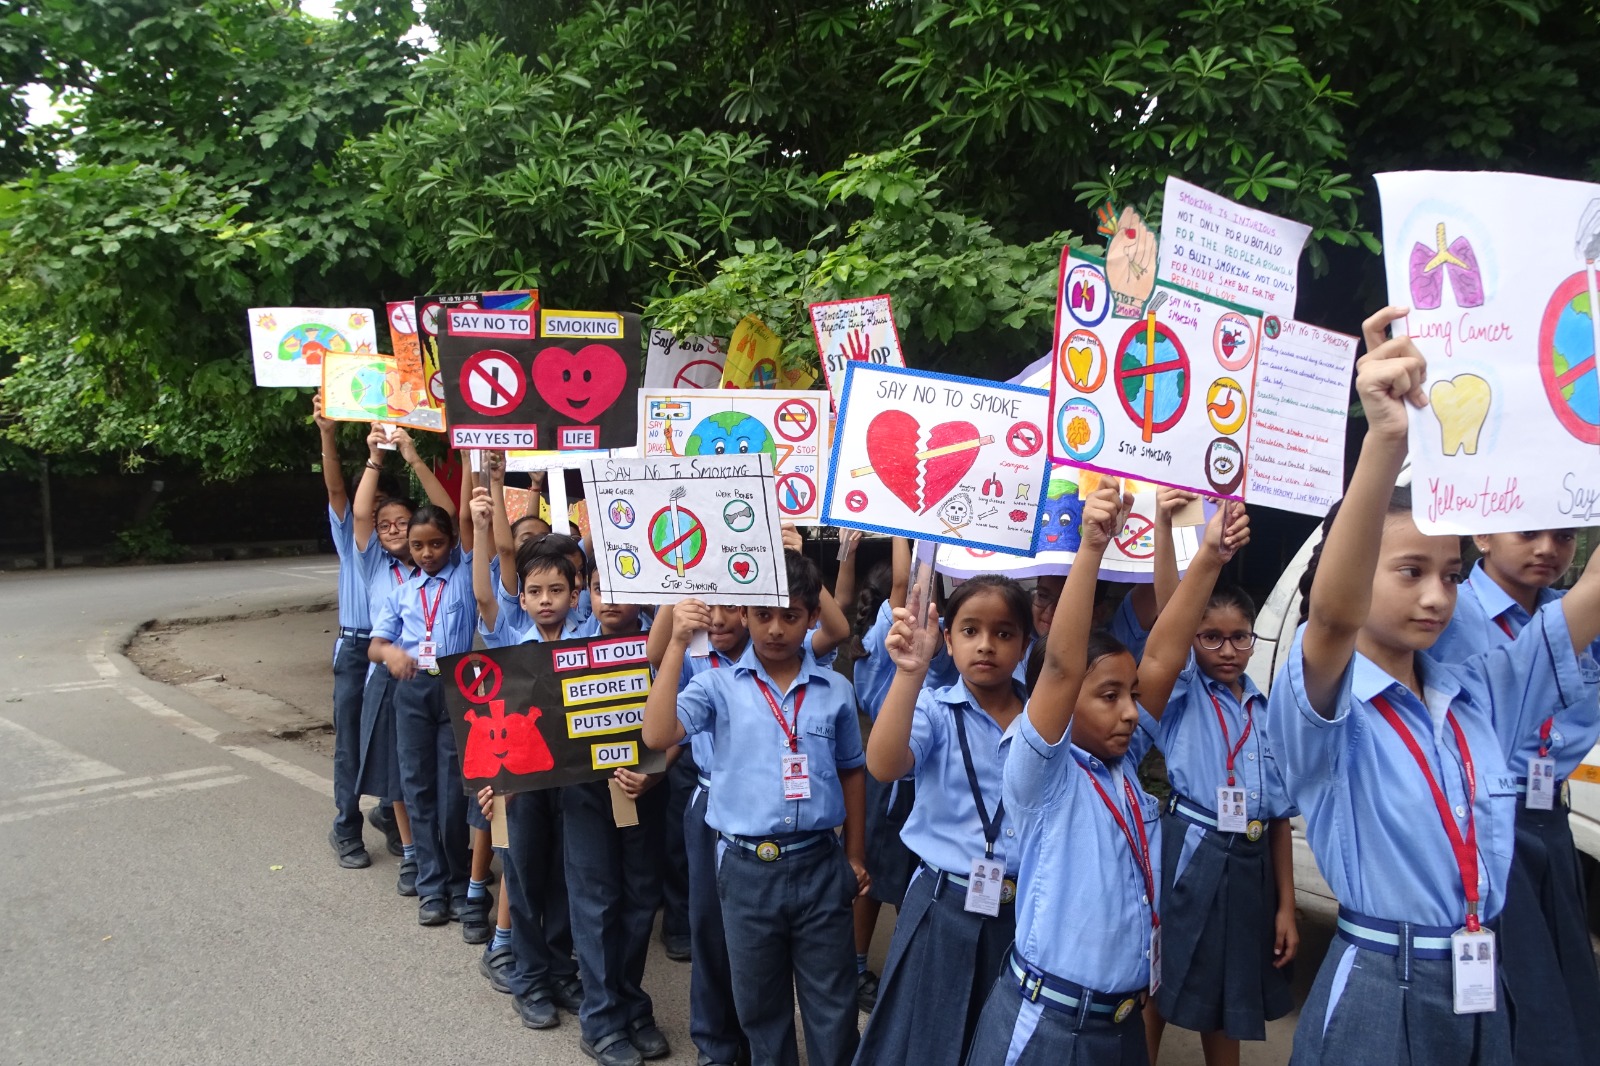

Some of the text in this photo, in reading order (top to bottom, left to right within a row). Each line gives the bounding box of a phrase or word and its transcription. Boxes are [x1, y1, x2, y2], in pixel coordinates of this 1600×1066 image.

[1179, 191, 1277, 237] SMOKING IS INJURIOUS
[1178, 210, 1194, 224] NOT
[1200, 217, 1220, 233] ONLY
[1225, 228, 1242, 243] FOR
[1176, 226, 1194, 242] FOR
[1201, 236, 1217, 251] THE
[1224, 245, 1254, 263] PEOPLE
[1171, 260, 1188, 274] FOR
[1191, 267, 1215, 282] YOUR
[1218, 276, 1236, 288] SAKE
[1173, 244, 1295, 293] SO QUIT SMOKING NOT ONLY
[1171, 273, 1199, 291] PEOPLE
[1215, 290, 1237, 303] LOVE
[1168, 295, 1181, 307] SAY
[453, 316, 530, 331] SAY NO TO
[548, 319, 618, 334] SMOKING
[1168, 310, 1198, 330] SMOKING
[1282, 321, 1296, 335] SAY
[1405, 312, 1514, 357] Lung Cancer
[876, 380, 1022, 419] SAY NO TO SMOKE
[648, 421, 663, 430] SAY
[649, 430, 659, 438] NO
[456, 432, 534, 445] SAY YES TO
[565, 432, 593, 444] LIFE
[796, 445, 817, 454] STOP
[1118, 440, 1172, 466] STOP SMOKING
[794, 465, 815, 473] STOP
[1428, 476, 1525, 523] Yellow teeth
[556, 653, 586, 667] PUT
[595, 643, 645, 661] IT OUT
[569, 677, 644, 698] BEFORE IT
[574, 715, 612, 731] PUTS
[598, 747, 630, 761] OUT
